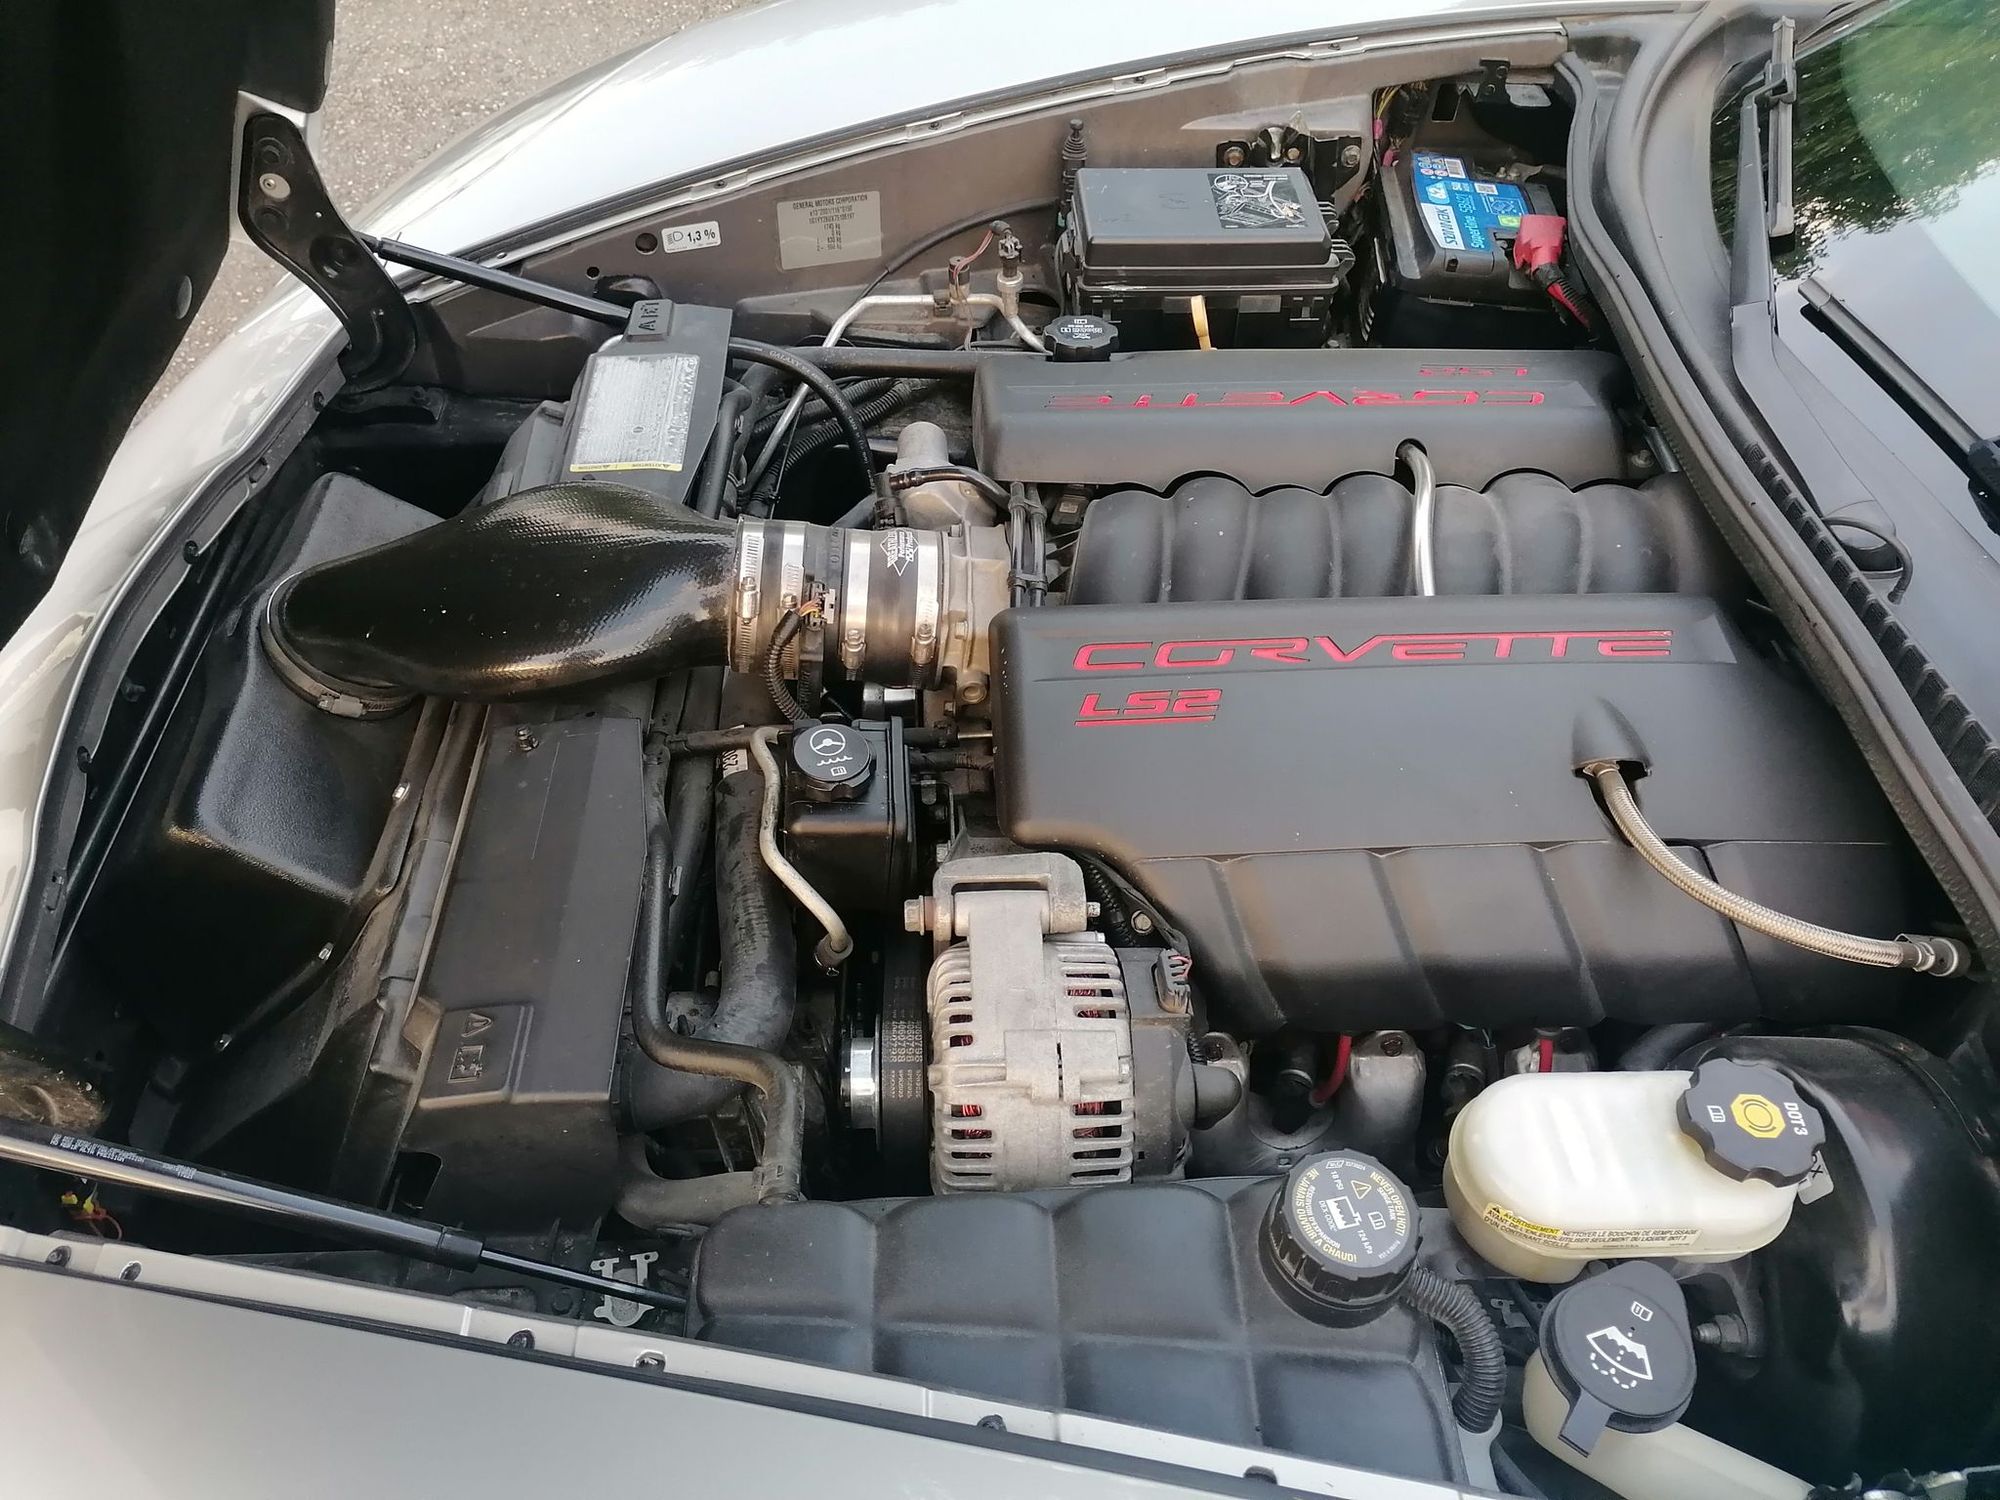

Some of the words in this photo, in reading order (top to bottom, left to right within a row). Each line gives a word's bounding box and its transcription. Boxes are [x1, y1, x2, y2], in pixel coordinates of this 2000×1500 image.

[793, 201, 814, 210] GENERAL
[815, 198, 835, 207] MOTORS
[836, 194, 868, 204] CORPORATION
[687, 230, 702, 244] 1,3
[703, 229, 716, 240] %
[1044, 390, 1546, 408] CORVETTE
[1073, 630, 1673, 671] CORVETTE
[1078, 688, 1222, 717] LS2
[1783, 1102, 1806, 1127] DOT
[1793, 1126, 1809, 1136] 3
[1306, 1168, 1320, 1180] NE
[1333, 1179, 1344, 1191] PSI
[1295, 1179, 1311, 1207] JAMAIS
[1370, 1171, 1395, 1196] NEVER
[1390, 1195, 1406, 1216] OPEN
[1296, 1208, 1319, 1242] OUVRIR
[1484, 1216, 1500, 1229] D'UN
[1500, 1225, 1543, 1244] CONTENANT
[1487, 1209, 1509, 1225] AVANT
[1508, 1222, 1519, 1230] DE
[1558, 1236, 1589, 1244] UTILISER
[1589, 1235, 1630, 1244] SEULEMENT
[1630, 1235, 1641, 1243] DU
[1641, 1235, 1668, 1243] LIQUIDE
[1504, 1212, 1561, 1235] AVERTISSEMENT
[1562, 1230, 1598, 1238] NETTOYER
[1606, 1230, 1640, 1238] BOUCHON
[1641, 1229, 1652, 1237] DE
[1652, 1228, 1698, 1237] REMPLISSAGE
[1322, 1243, 1358, 1263] CHAUD!
